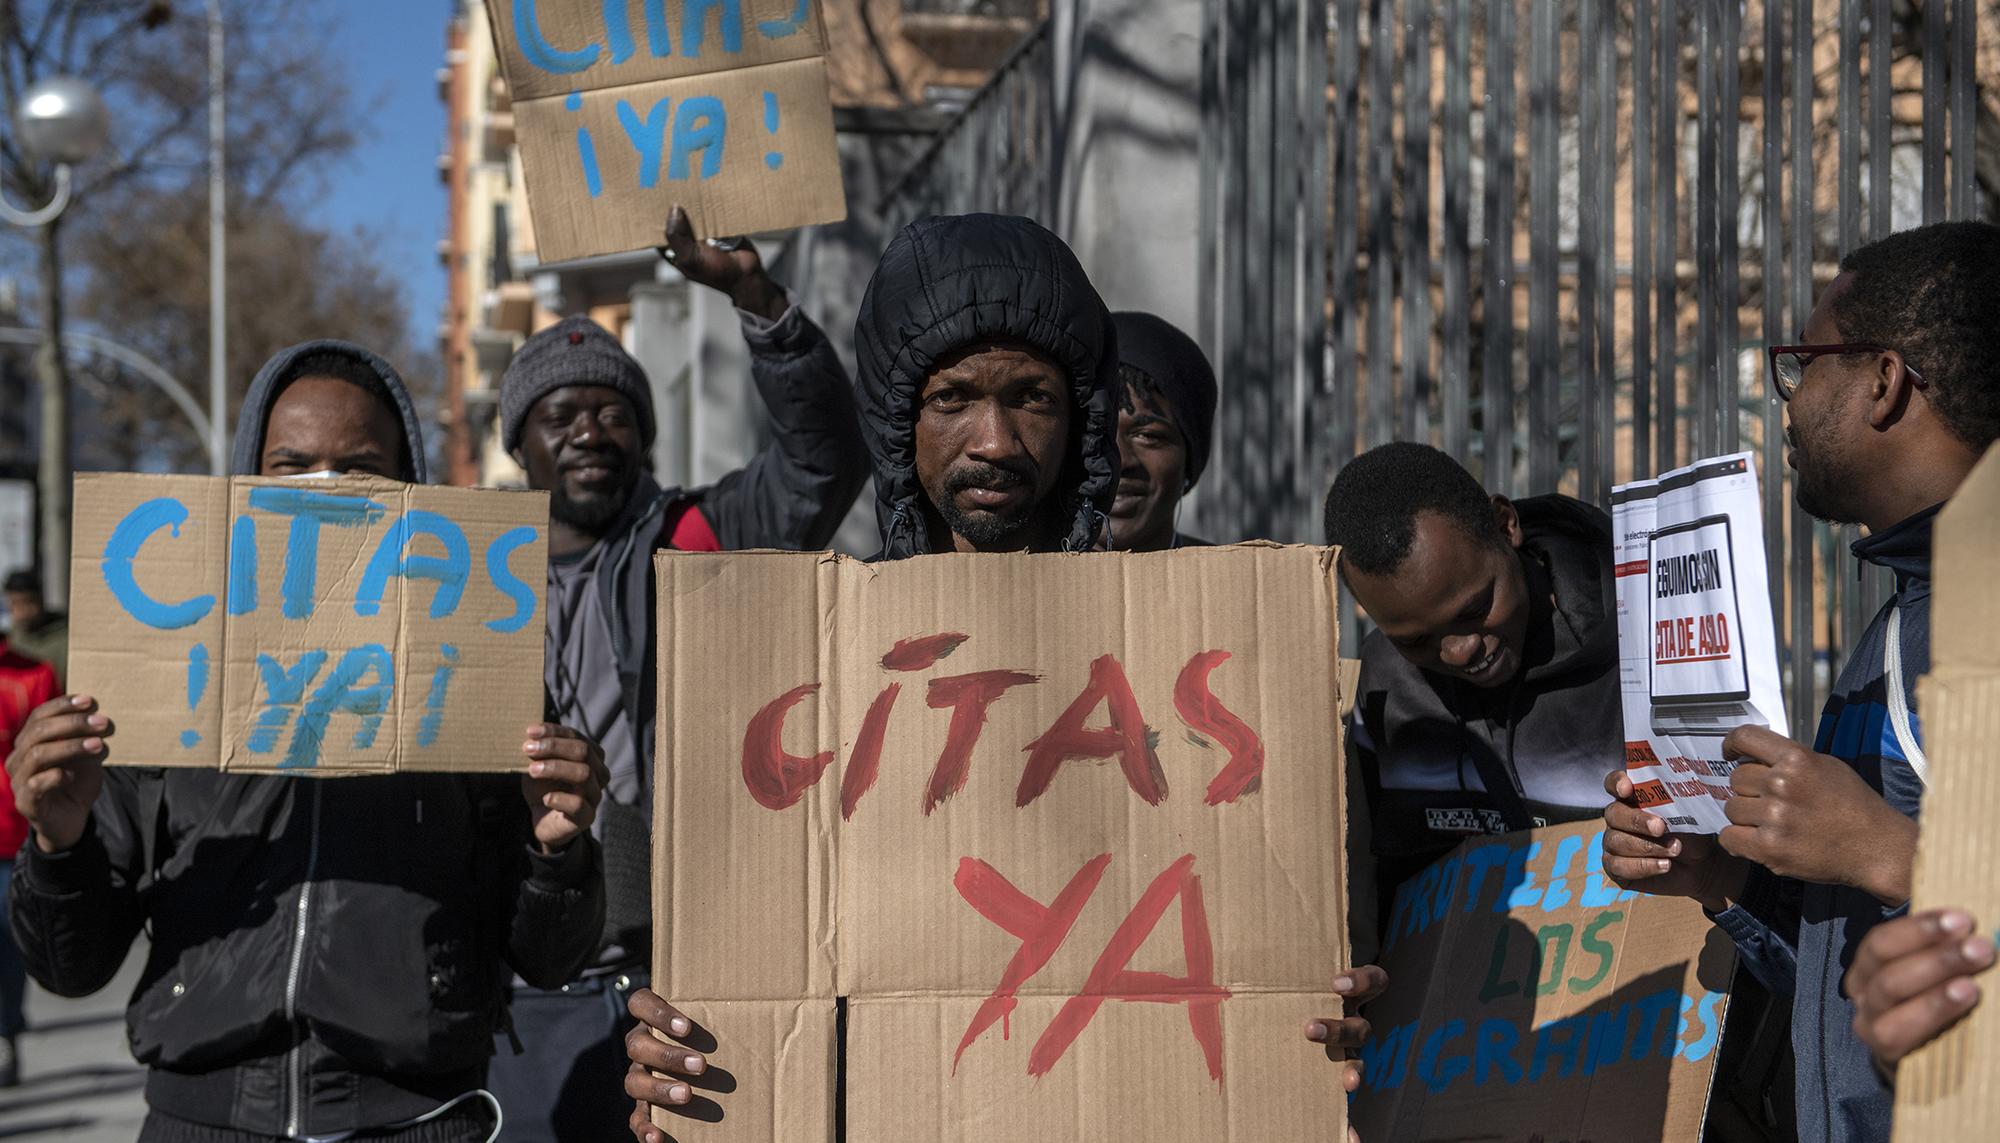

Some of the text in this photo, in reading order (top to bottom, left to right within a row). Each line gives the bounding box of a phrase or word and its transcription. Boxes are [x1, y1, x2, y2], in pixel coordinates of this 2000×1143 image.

[102, 486, 539, 634] CITAS
[1677, 616, 1696, 657] DE
[951, 853, 1232, 1096] YA
[1479, 910, 1624, 1003] LOS
[1348, 987, 1725, 1104] MIGRANTES
